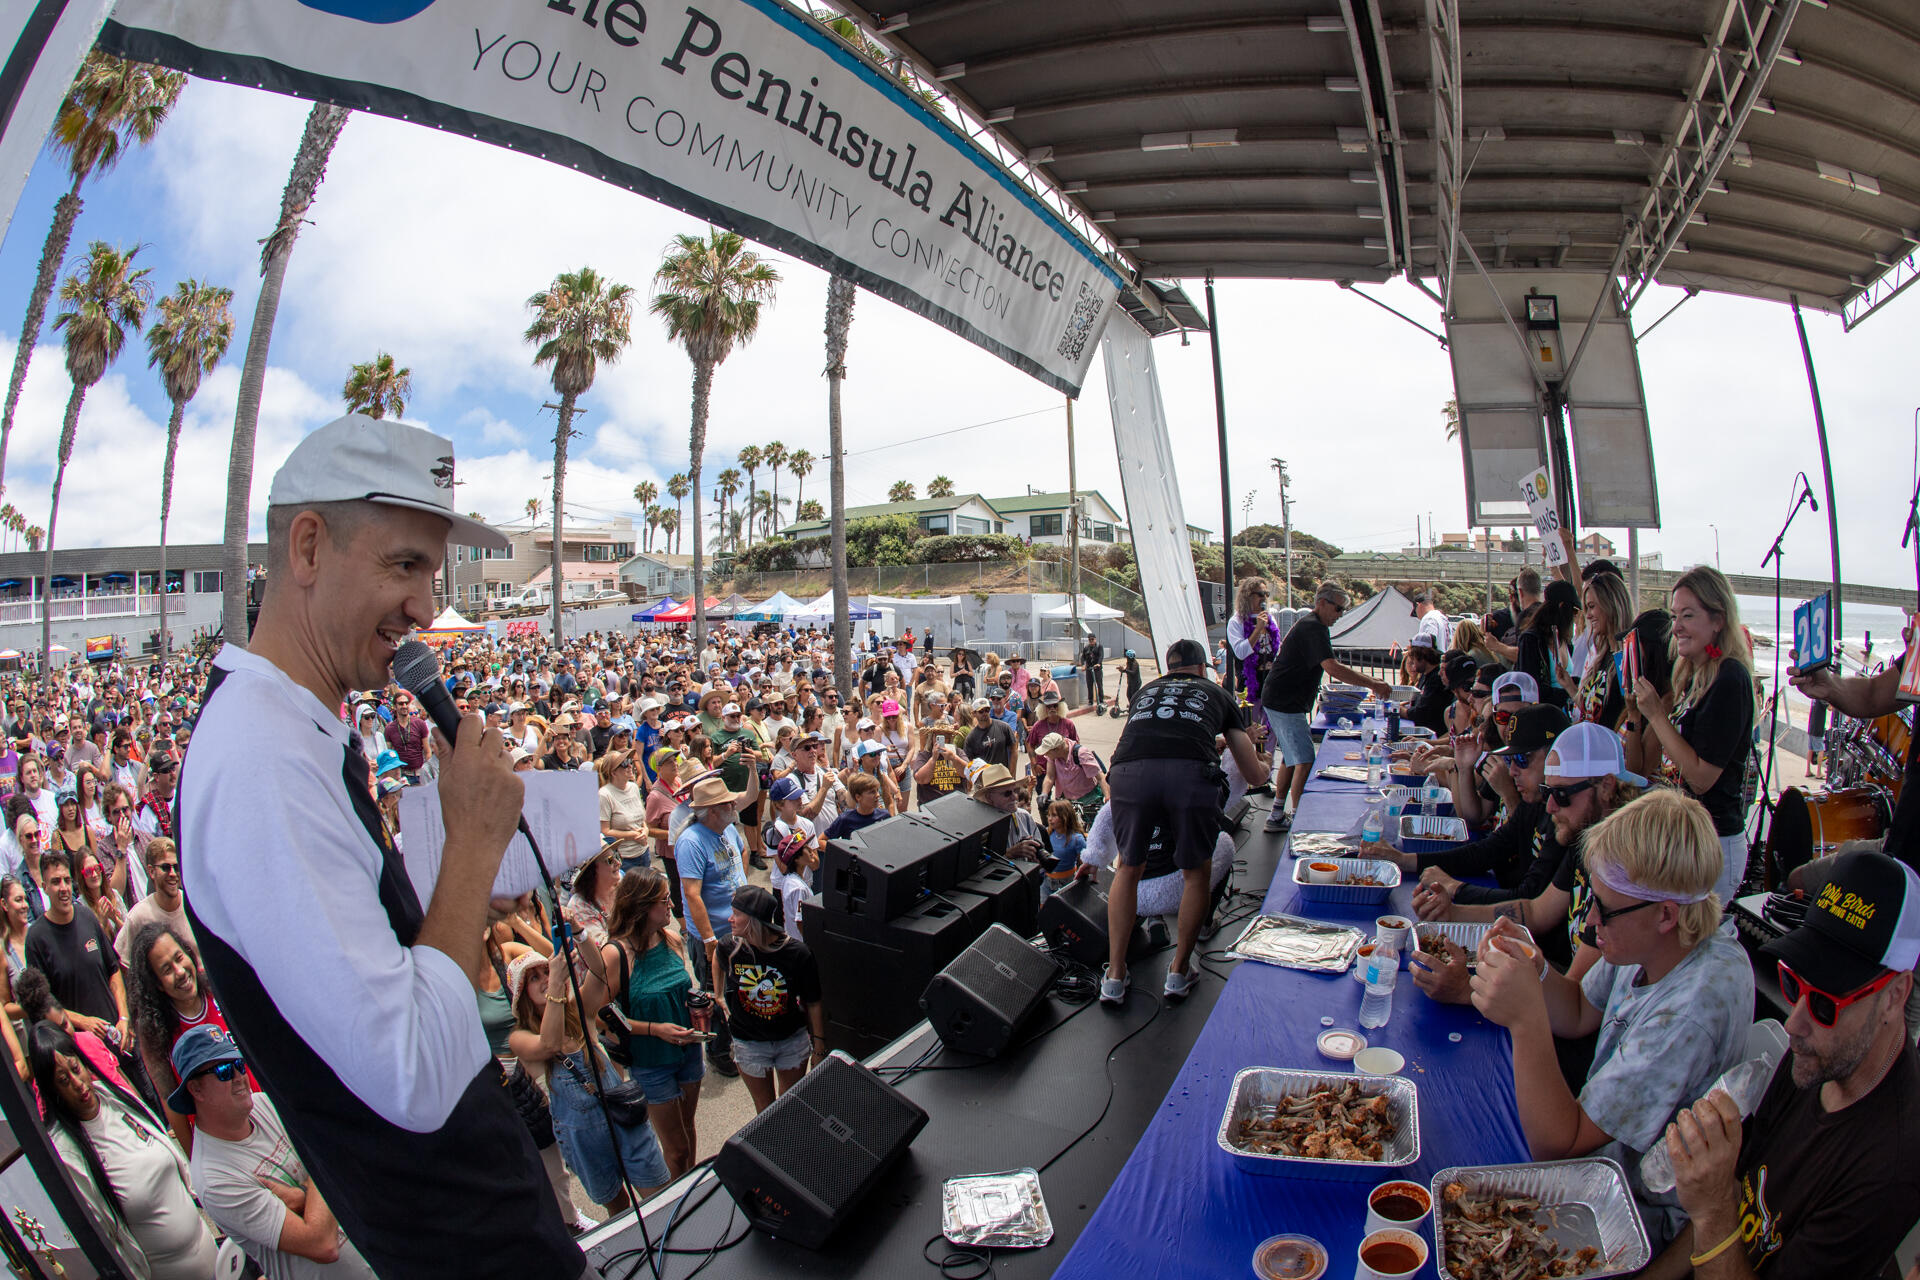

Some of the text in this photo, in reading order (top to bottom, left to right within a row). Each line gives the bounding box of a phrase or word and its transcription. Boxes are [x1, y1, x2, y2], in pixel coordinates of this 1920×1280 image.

[473, 28, 607, 112] YOUR
[626, 96, 862, 231] COMMUNITY
[661, 6, 930, 214] Peninsula
[939, 181, 1065, 302] Alliance
[1797, 607, 1826, 668] 23
[1840, 892, 1876, 919] Birds
[1845, 912, 1867, 930] EATER
